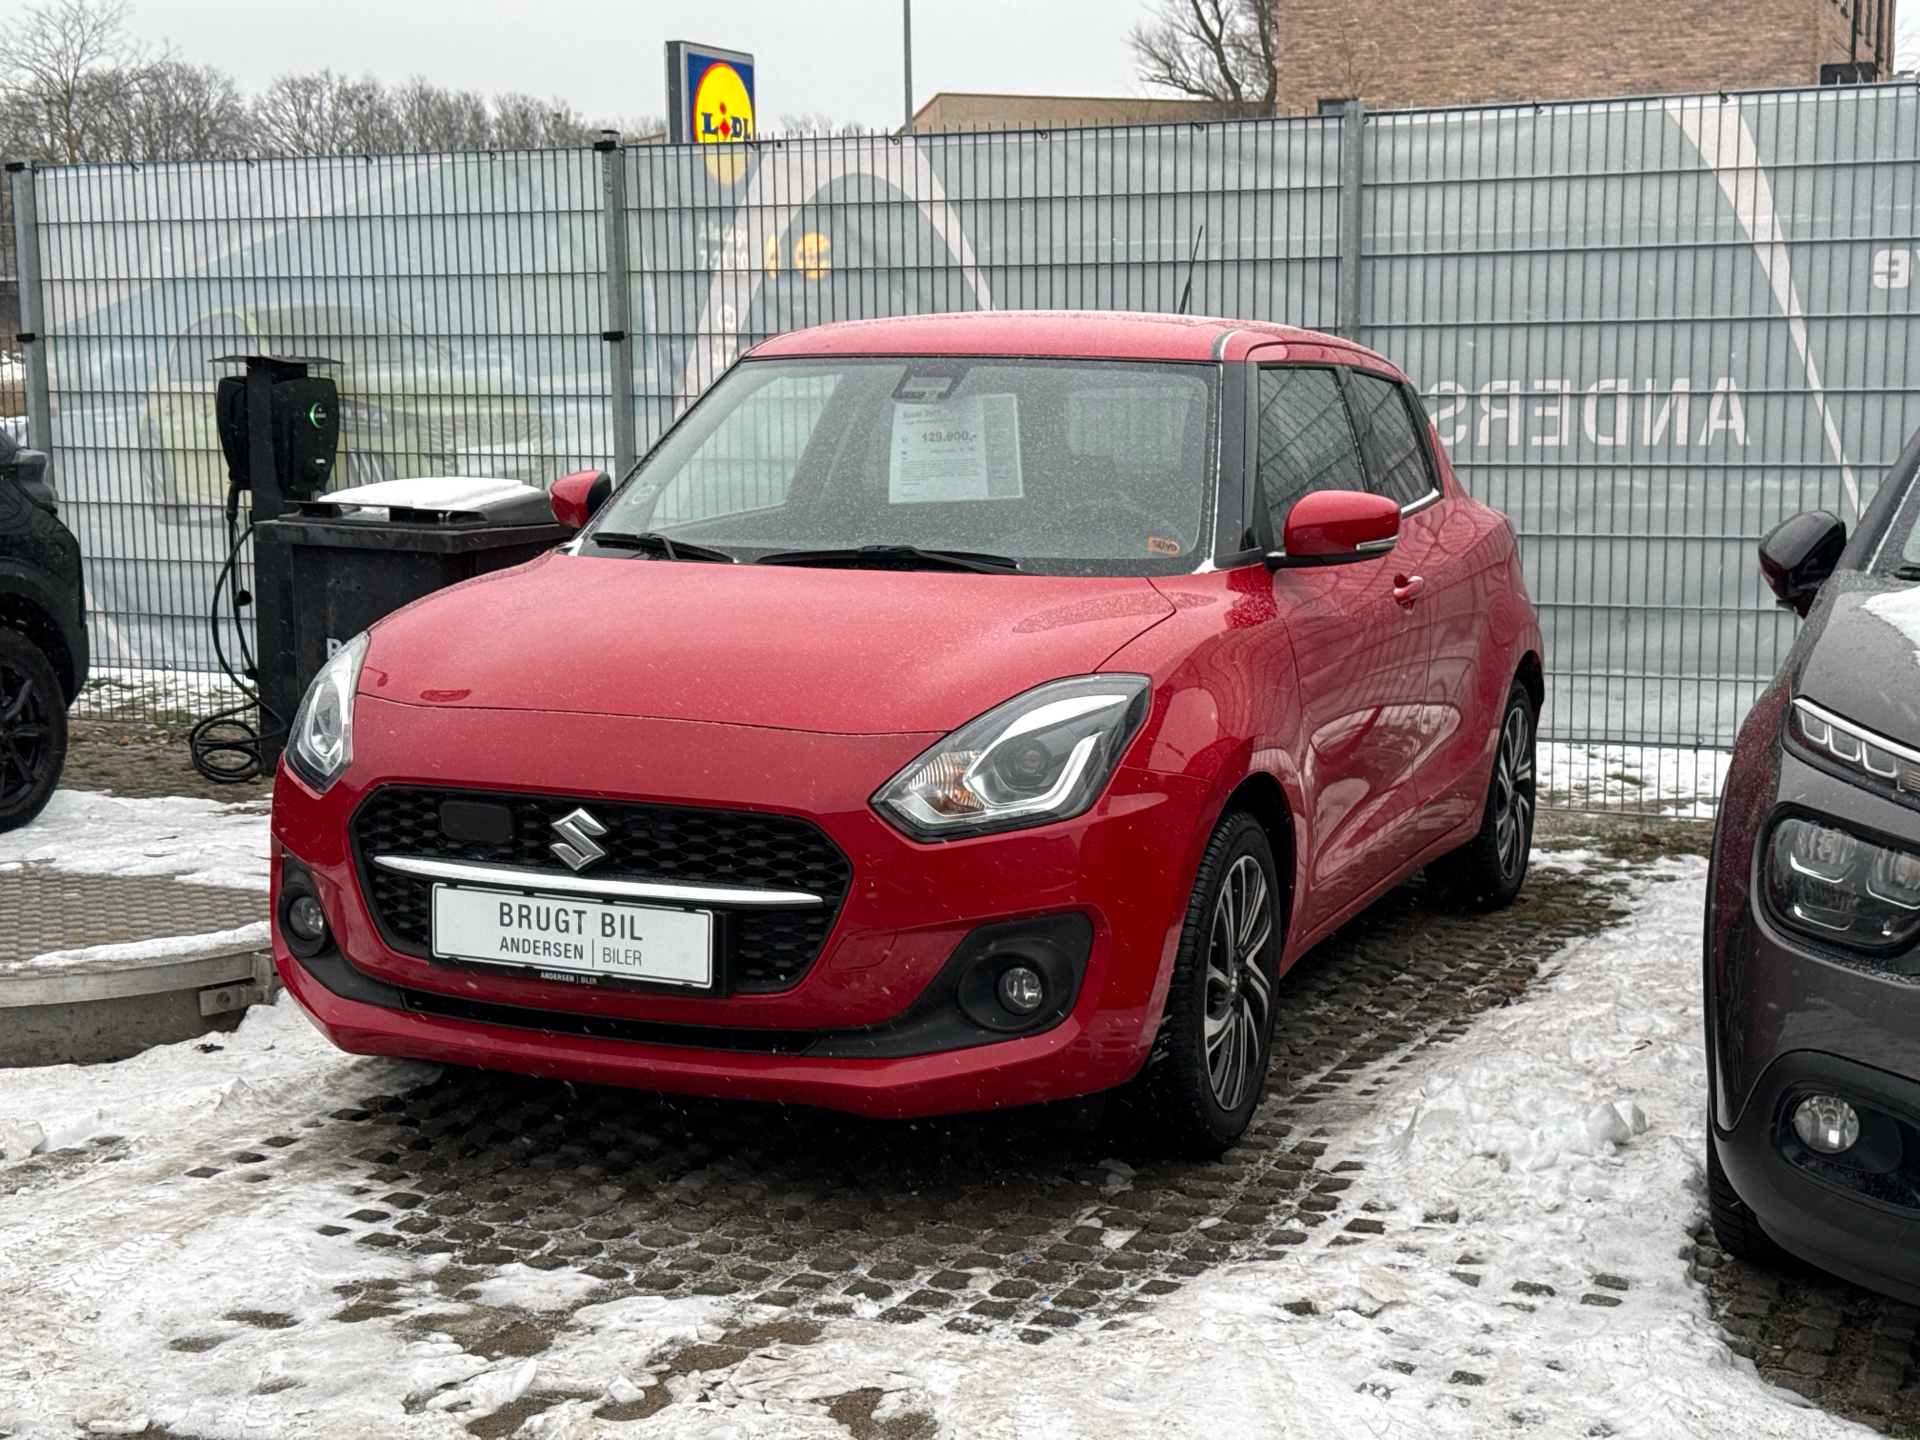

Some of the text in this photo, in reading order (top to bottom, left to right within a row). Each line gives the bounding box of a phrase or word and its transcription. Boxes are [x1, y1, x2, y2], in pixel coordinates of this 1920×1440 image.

[499, 901, 643, 941] BRUGT BIL
[499, 935, 642, 967] ANDERSEN BILER
[540, 971, 597, 985] ANDERSEN BILER
